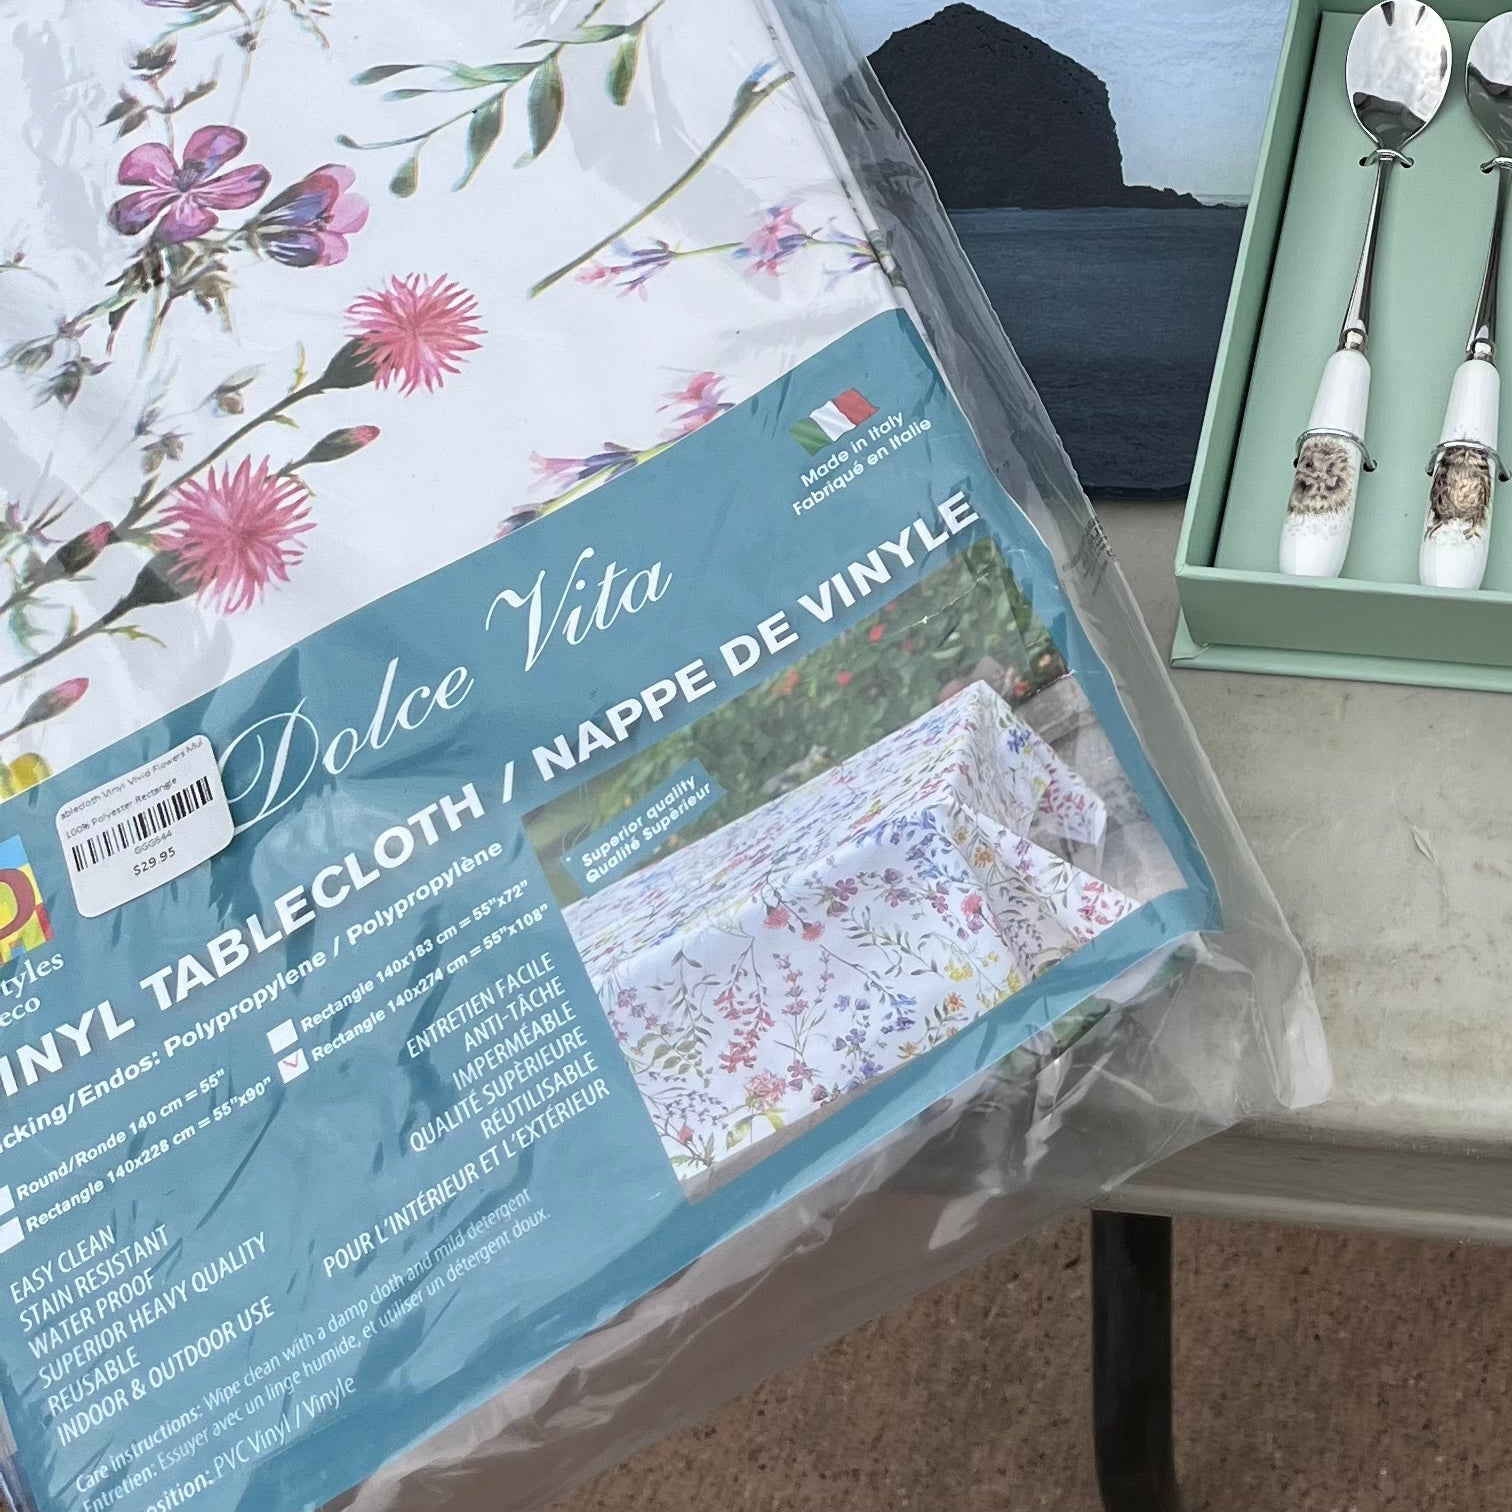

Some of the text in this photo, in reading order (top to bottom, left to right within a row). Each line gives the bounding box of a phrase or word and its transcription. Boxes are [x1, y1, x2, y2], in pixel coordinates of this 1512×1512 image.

[792, 419, 931, 516] Fabriqué en Italie
[800, 412, 904, 488] Made in Italy
[217, 546, 673, 836] Dolce Vita
[0, 999, 136, 1097] INYL
[140, 782, 486, 1012] TABLECLOTH
[501, 760, 516, 804] /
[530, 658, 717, 782] NAPPE
[719, 610, 799, 677] DE
[797, 490, 982, 624] VINYLE
[66, 777, 178, 840] 100% Polyester Rectangle
[581, 775, 696, 867] Superior quality
[132, 846, 177, 877] $29.95
[586, 836, 641, 883] Qualité
[0, 842, 503, 1154] cking/Endos: Polypropylene / Polypropylène
[301, 979, 374, 1033] Rectangle
[376, 939, 434, 983] 140x183
[436, 925, 458, 945] cm
[459, 916, 472, 929] =
[311, 1010, 386, 1062] Rectangle
[387, 968, 444, 1013] 140x274
[446, 954, 468, 974] cm
[470, 945, 482, 958] =
[406, 951, 556, 1059] ENTRETIEN FACILE
[463, 975, 566, 1053] ANTI-TÂCHE
[452, 1000, 577, 1091] IMPERMÉABLE
[480, 1051, 599, 1139] RÉUTILISABLE
[16, 1130, 127, 1202] Round/Ronde
[128, 1111, 157, 1136] 140
[160, 1098, 184, 1118] cm
[185, 1089, 198, 1102] =
[25, 1179, 105, 1232] Rectangle
[106, 1140, 170, 1184] 140x228
[172, 1125, 196, 1146] cm
[198, 1116, 211, 1129] =
[409, 1089, 483, 1153] QUALITÉ
[322, 1078, 610, 1278] POUR L'INTÉRIEUR ET L'EXTÉRIEUR
[9, 1224, 116, 1305] EASY CLEAN
[19, 1224, 169, 1333] STAIN RESISTANT
[28, 1268, 156, 1360] WATER PROOF
[38, 1231, 266, 1389] SUPERIOR HEAVY QUALITY
[48, 1346, 141, 1417] REUSABLE
[57, 1295, 275, 1447] INDOOR & OUTDOOR USE
[75, 1188, 532, 1493] Care instructions: Wipe clean with a damp cloth and mild detergent
[156, 1428, 210, 1471] Essuyer
[212, 1409, 245, 1437] avec
[245, 1397, 264, 1414] un
[266, 1368, 303, 1403] linge
[302, 1334, 363, 1377] humide,
[362, 1324, 378, 1340] et
[378, 1291, 424, 1330] utiliser
[426, 1279, 445, 1297] un
[446, 1231, 511, 1283] détergent
[512, 1206, 552, 1239] doux.
[213, 1440, 249, 1479] PVC
[247, 1413, 291, 1455] Vinyl
[302, 1375, 356, 1418] Vinyle
